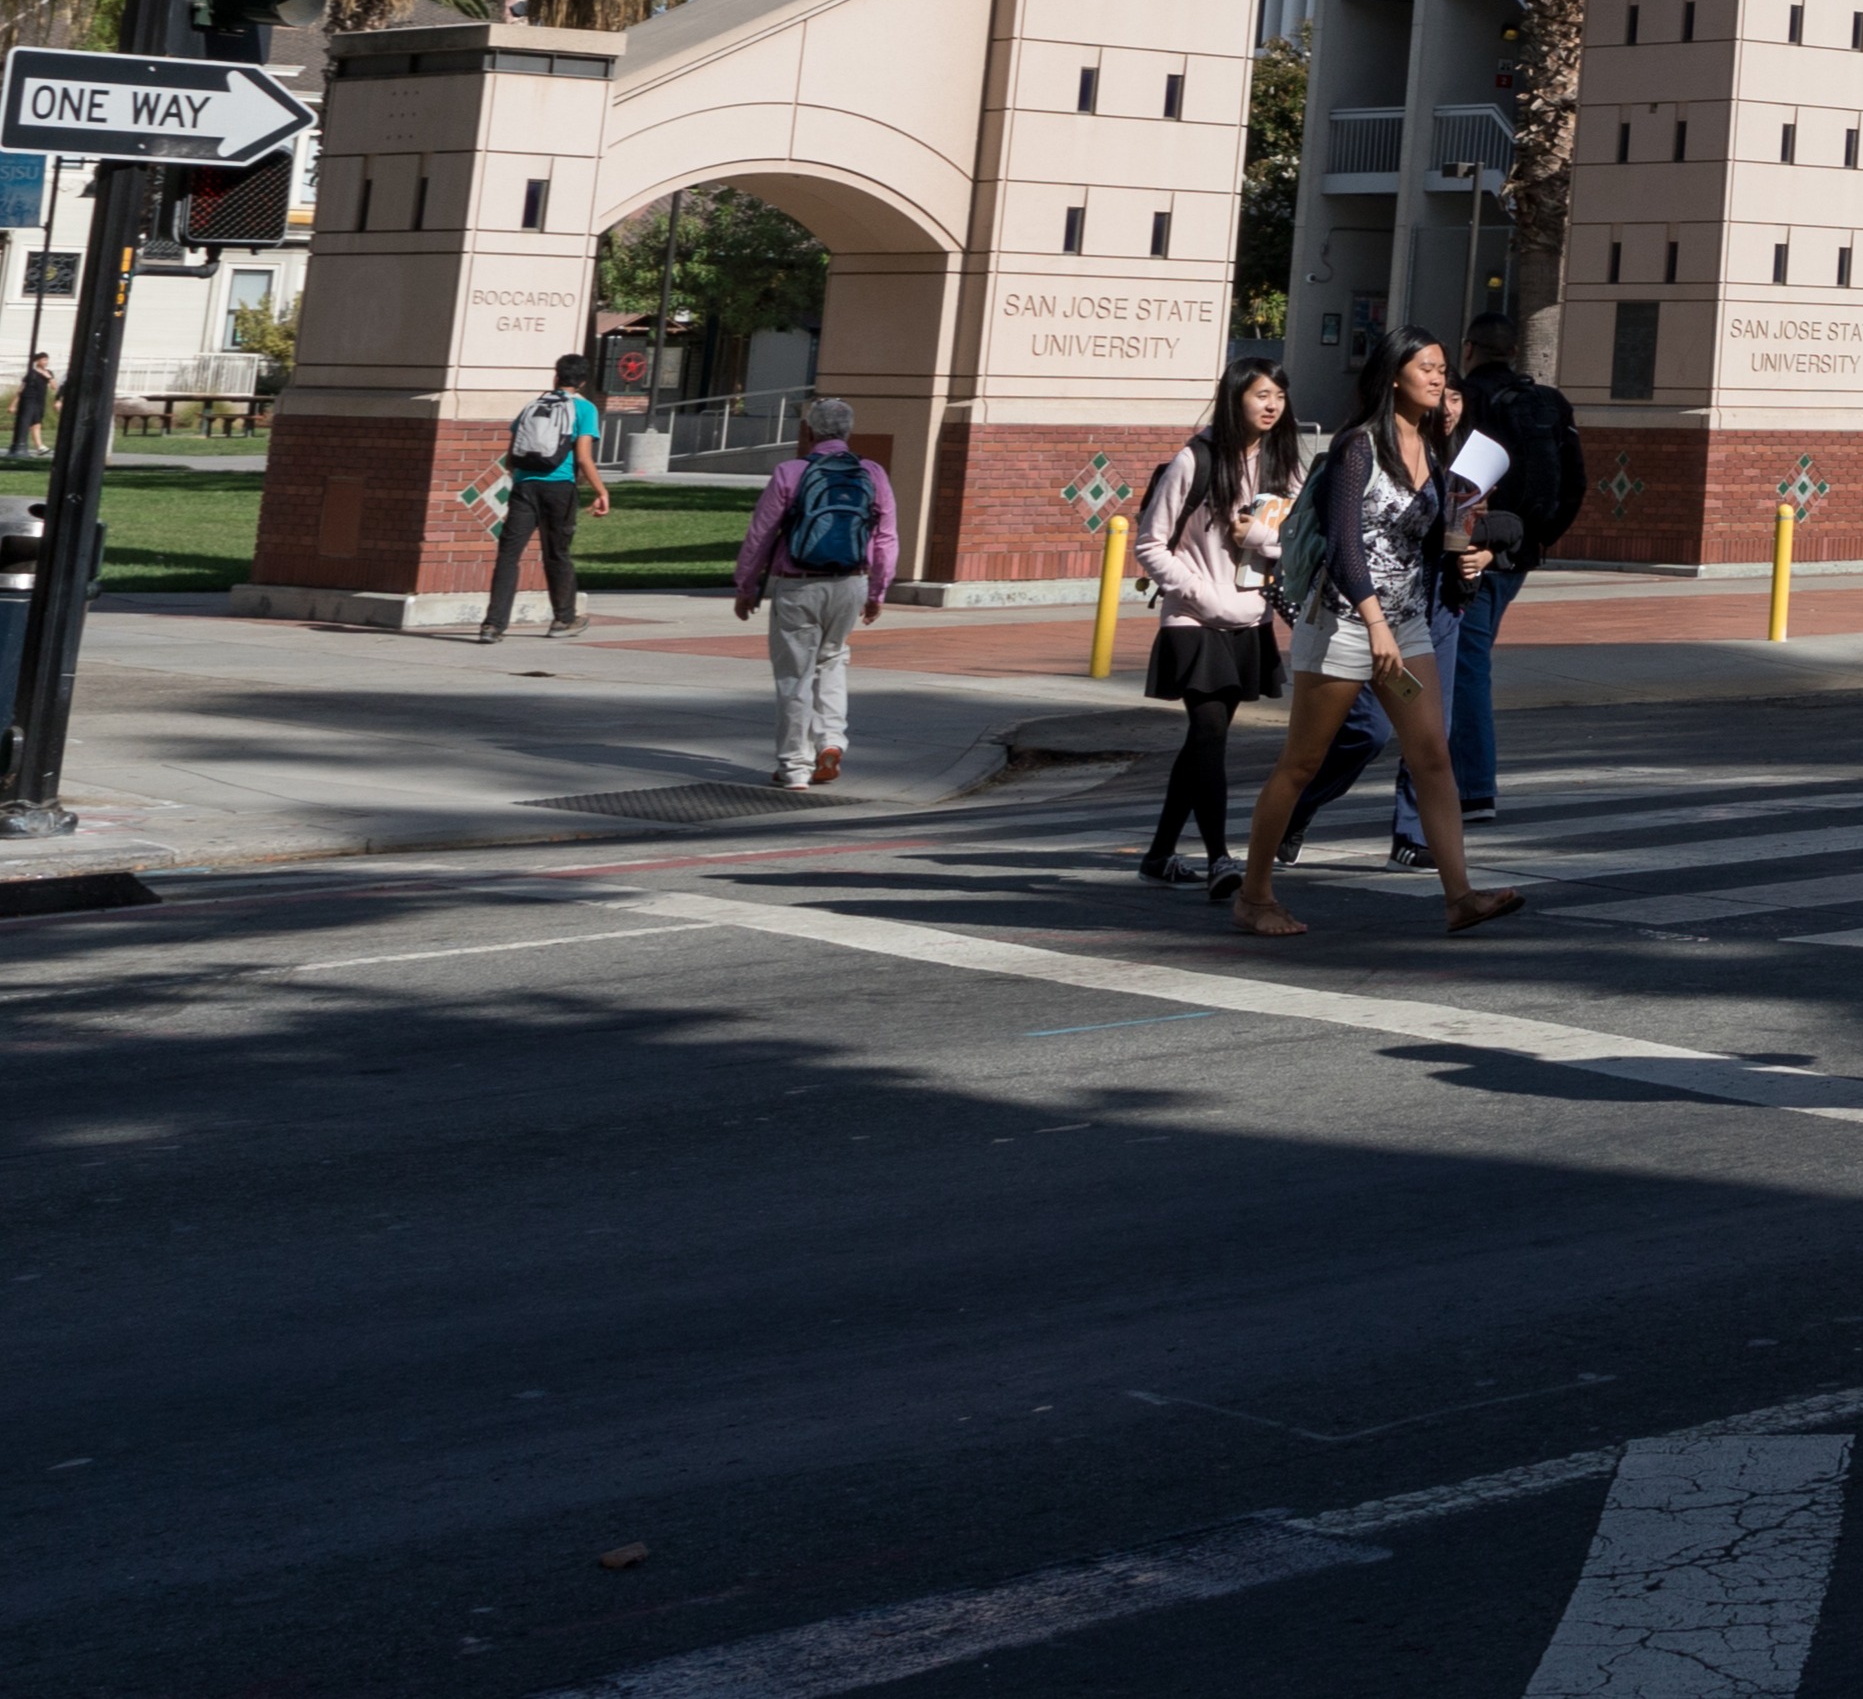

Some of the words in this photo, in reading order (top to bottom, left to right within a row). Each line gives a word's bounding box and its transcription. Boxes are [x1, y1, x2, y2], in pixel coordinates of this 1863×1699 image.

[31, 84, 110, 124] ONE
[132, 90, 213, 129] WAY
[472, 289, 576, 308] BOCCARDO
[1003, 293, 1056, 318] SAN
[1062, 296, 1129, 320] JOSE
[1135, 298, 1214, 323] STATE
[496, 316, 546, 333] GATE
[1730, 318, 1769, 340] SAN
[1774, 320, 1822, 341] JOSE
[1031, 333, 1181, 359] UNIVERSITY
[1751, 352, 1861, 374] UNIVERSITY
